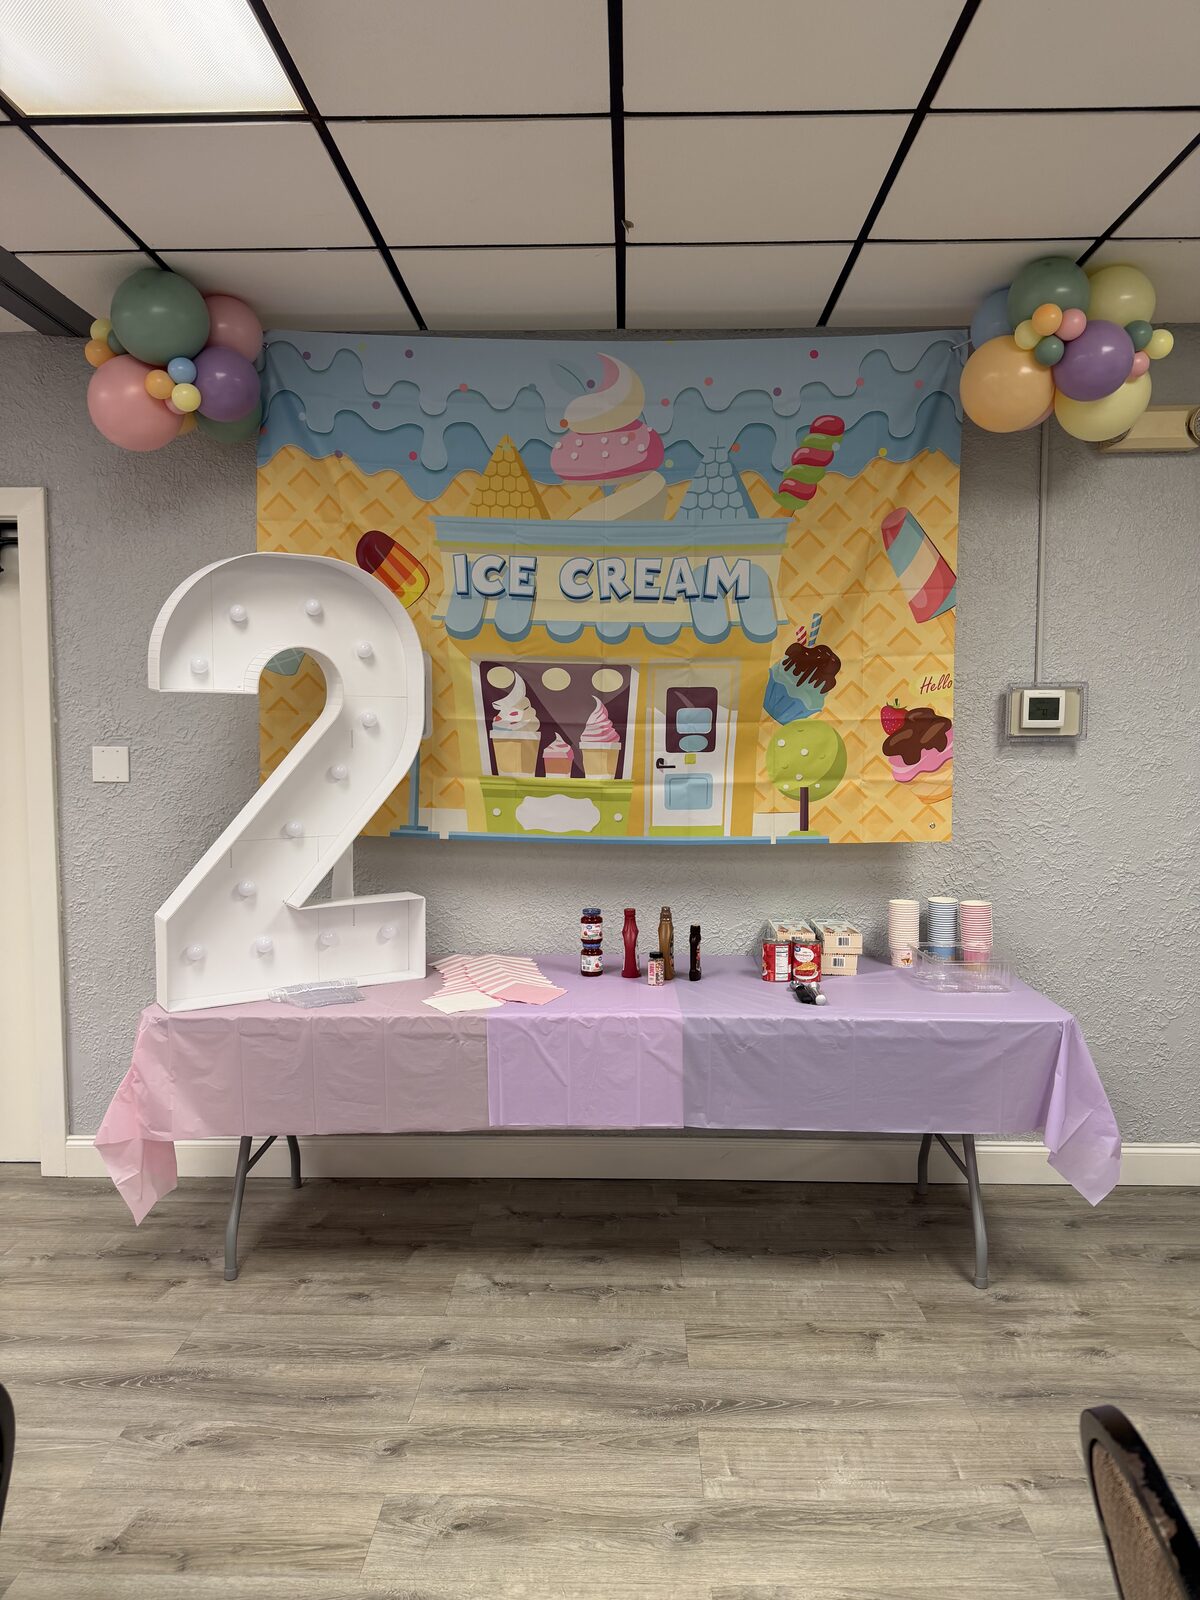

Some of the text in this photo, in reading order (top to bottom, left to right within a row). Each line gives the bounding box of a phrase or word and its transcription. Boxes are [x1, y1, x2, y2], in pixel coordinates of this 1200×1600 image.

[452, 553, 751, 601] ICE CREAM
[919, 672, 953, 695] Hello
[148, 552, 425, 1011] 2
